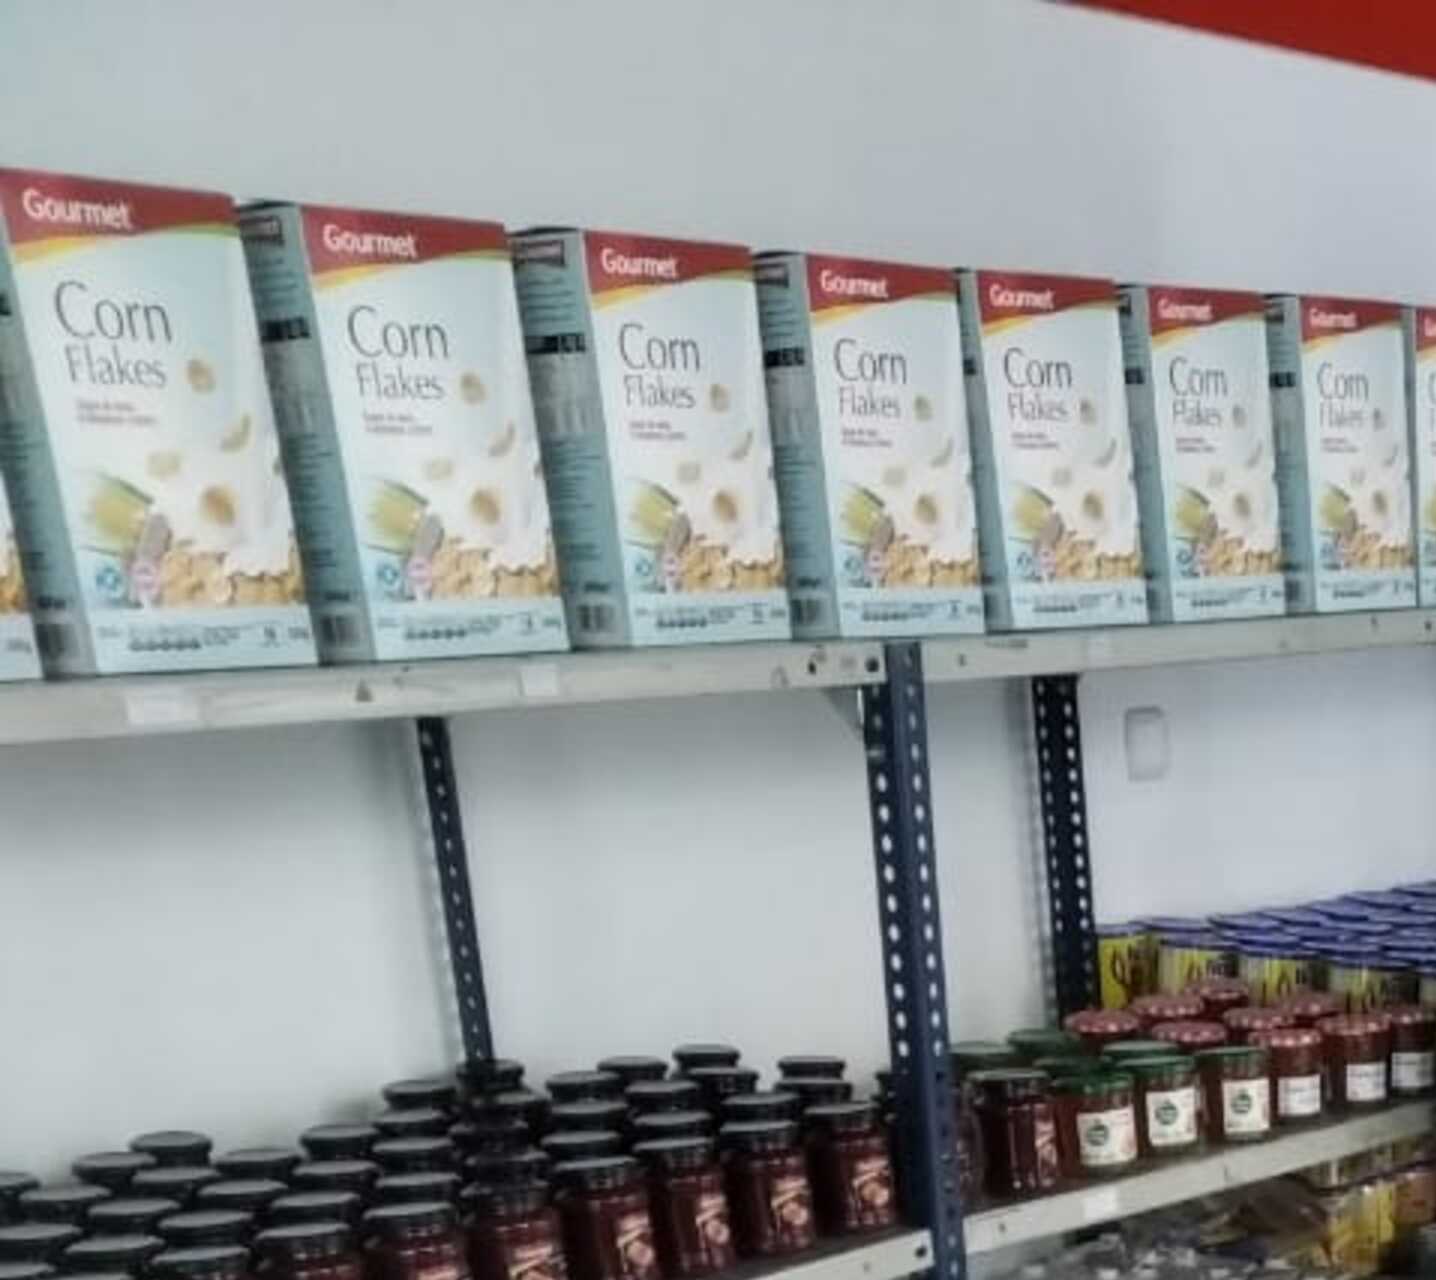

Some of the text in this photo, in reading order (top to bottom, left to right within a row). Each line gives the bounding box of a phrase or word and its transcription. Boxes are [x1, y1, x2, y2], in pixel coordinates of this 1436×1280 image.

[22, 187, 133, 229] Gourmet
[322, 222, 418, 258] Gourmet
[601, 247, 678, 278] Gourmet
[820, 268, 889, 297] Gourmet
[54, 279, 172, 343] Corn
[989, 283, 1054, 310] Gourmet
[347, 304, 449, 359] Corn
[619, 322, 701, 374] Corn
[65, 345, 168, 389] Flakes
[355, 361, 447, 401] Flakes
[833, 338, 907, 385] Corn
[1004, 347, 1072, 389] Corn
[1169, 356, 1229, 397] Corn
[1316, 362, 1370, 400] Corn
[623, 374, 697, 410] Flakes
[839, 386, 902, 420] Flakes
[1007, 391, 1069, 423] Flakes
